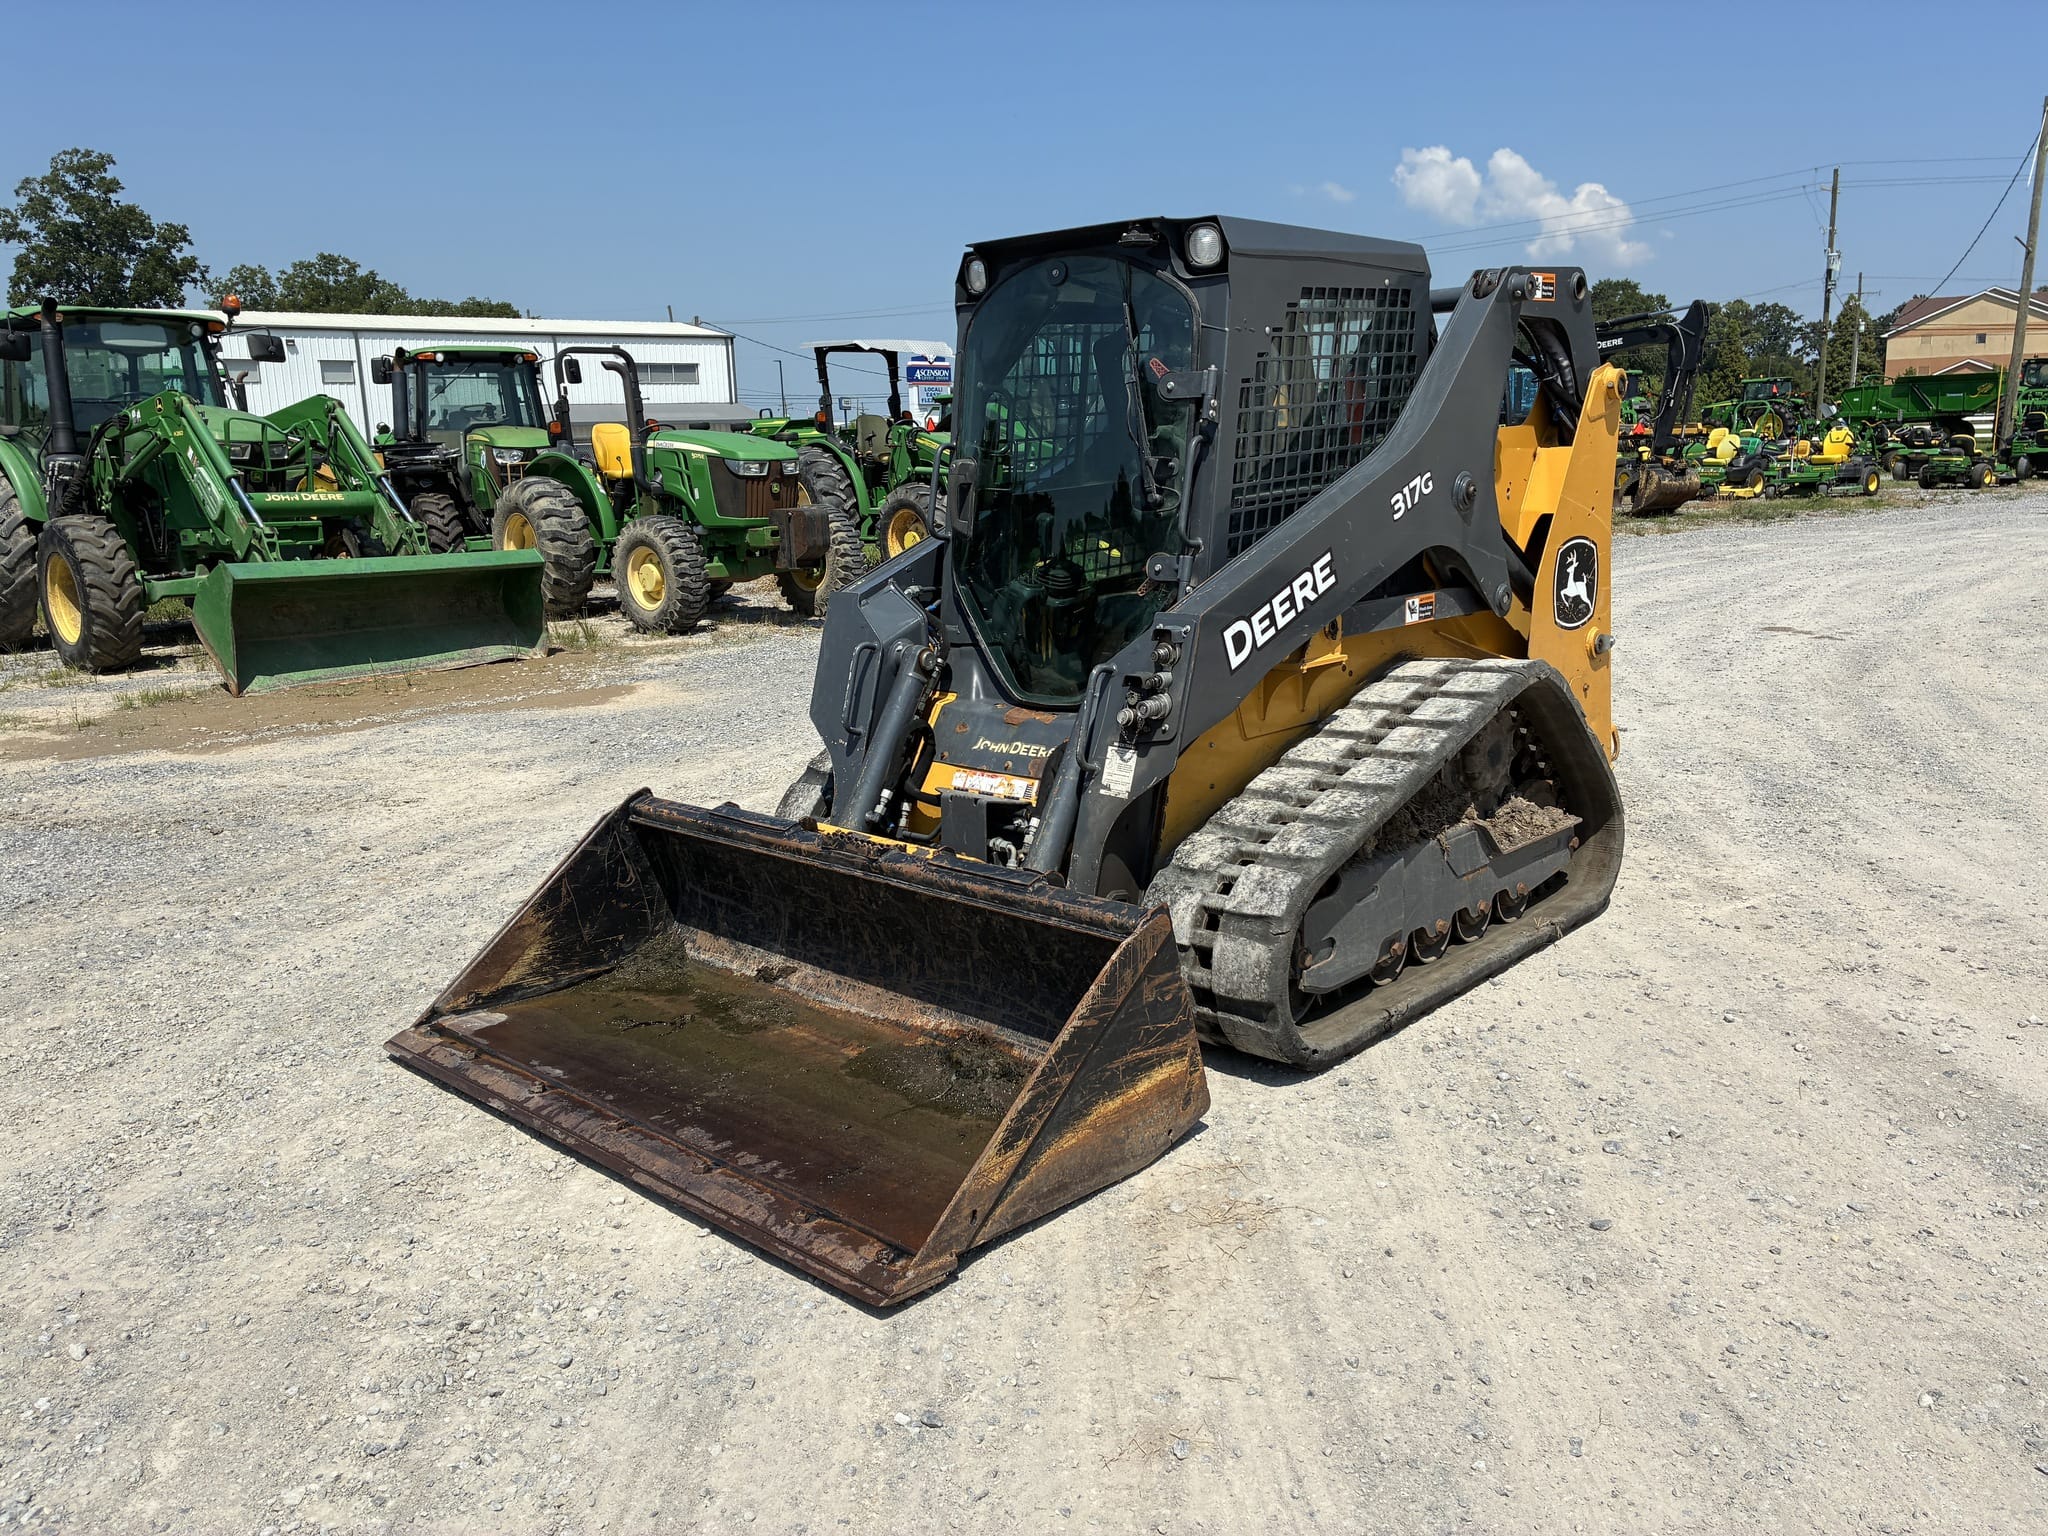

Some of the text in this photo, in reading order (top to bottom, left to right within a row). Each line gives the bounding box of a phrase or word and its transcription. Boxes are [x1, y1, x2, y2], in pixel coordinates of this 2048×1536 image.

[1596, 338, 1624, 349] DEERE
[913, 369, 949, 380] ASCENSION
[266, 493, 345, 502] JOHN DEERE
[1390, 471, 1434, 521] 317G
[1223, 551, 1337, 671] DEERE
[971, 736, 1009, 755] JOHN
